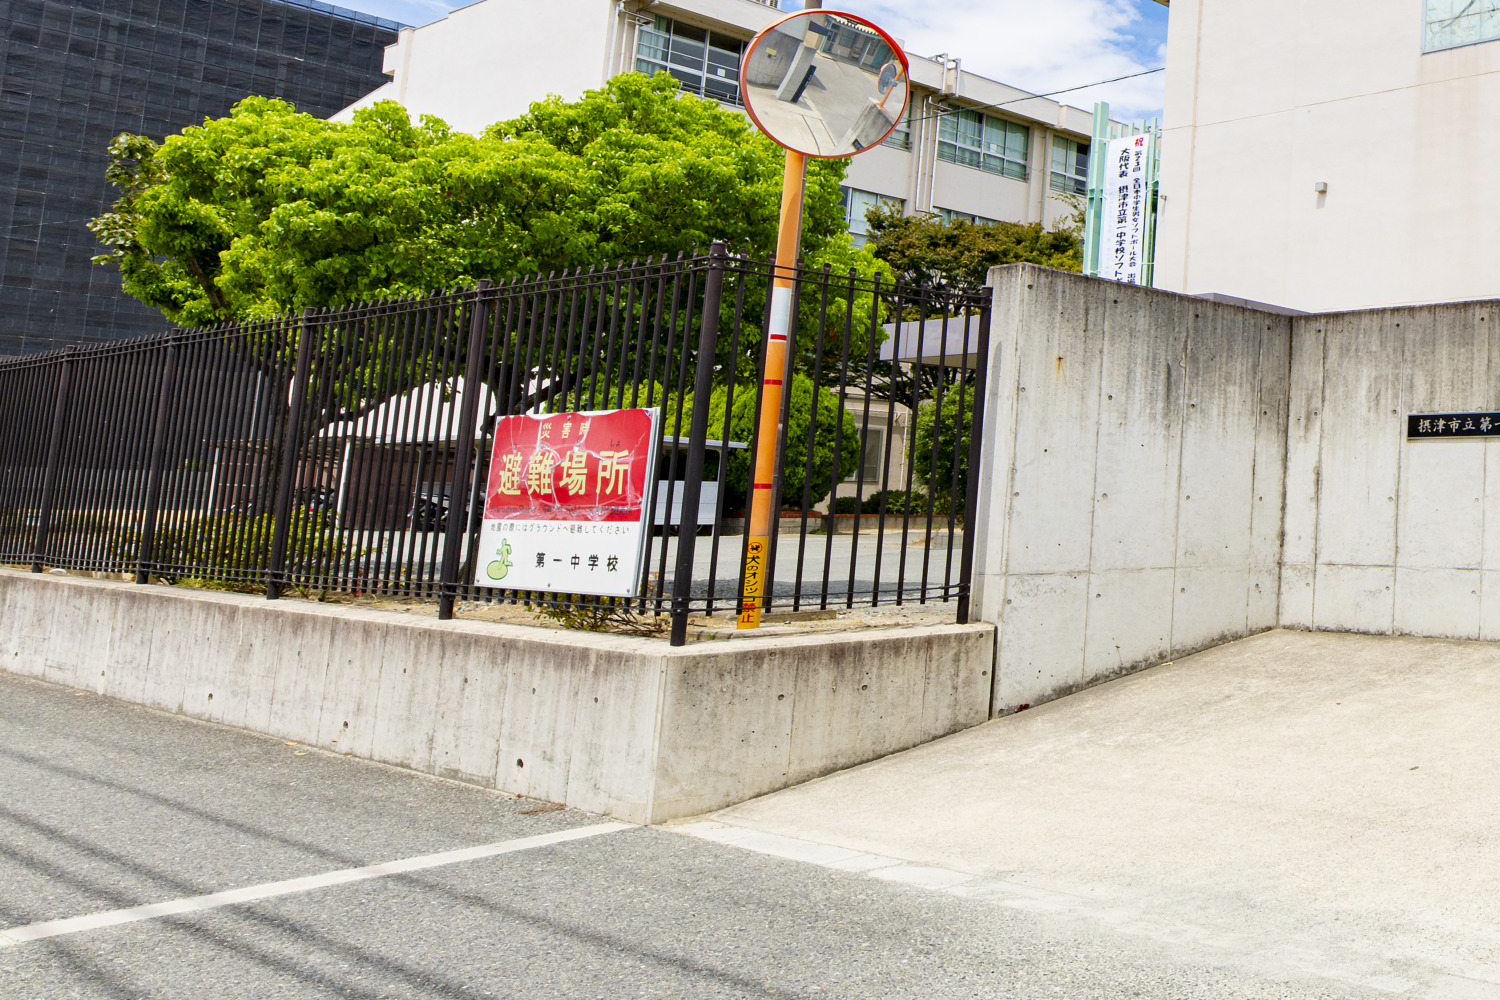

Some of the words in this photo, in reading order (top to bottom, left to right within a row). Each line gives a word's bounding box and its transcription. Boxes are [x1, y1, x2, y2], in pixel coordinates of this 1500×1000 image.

[1134, 137, 1144, 147] 祝
[541, 422, 590, 439] 災害時
[498, 450, 629, 495] 避難場所
[535, 552, 619, 572] 第一中学校
